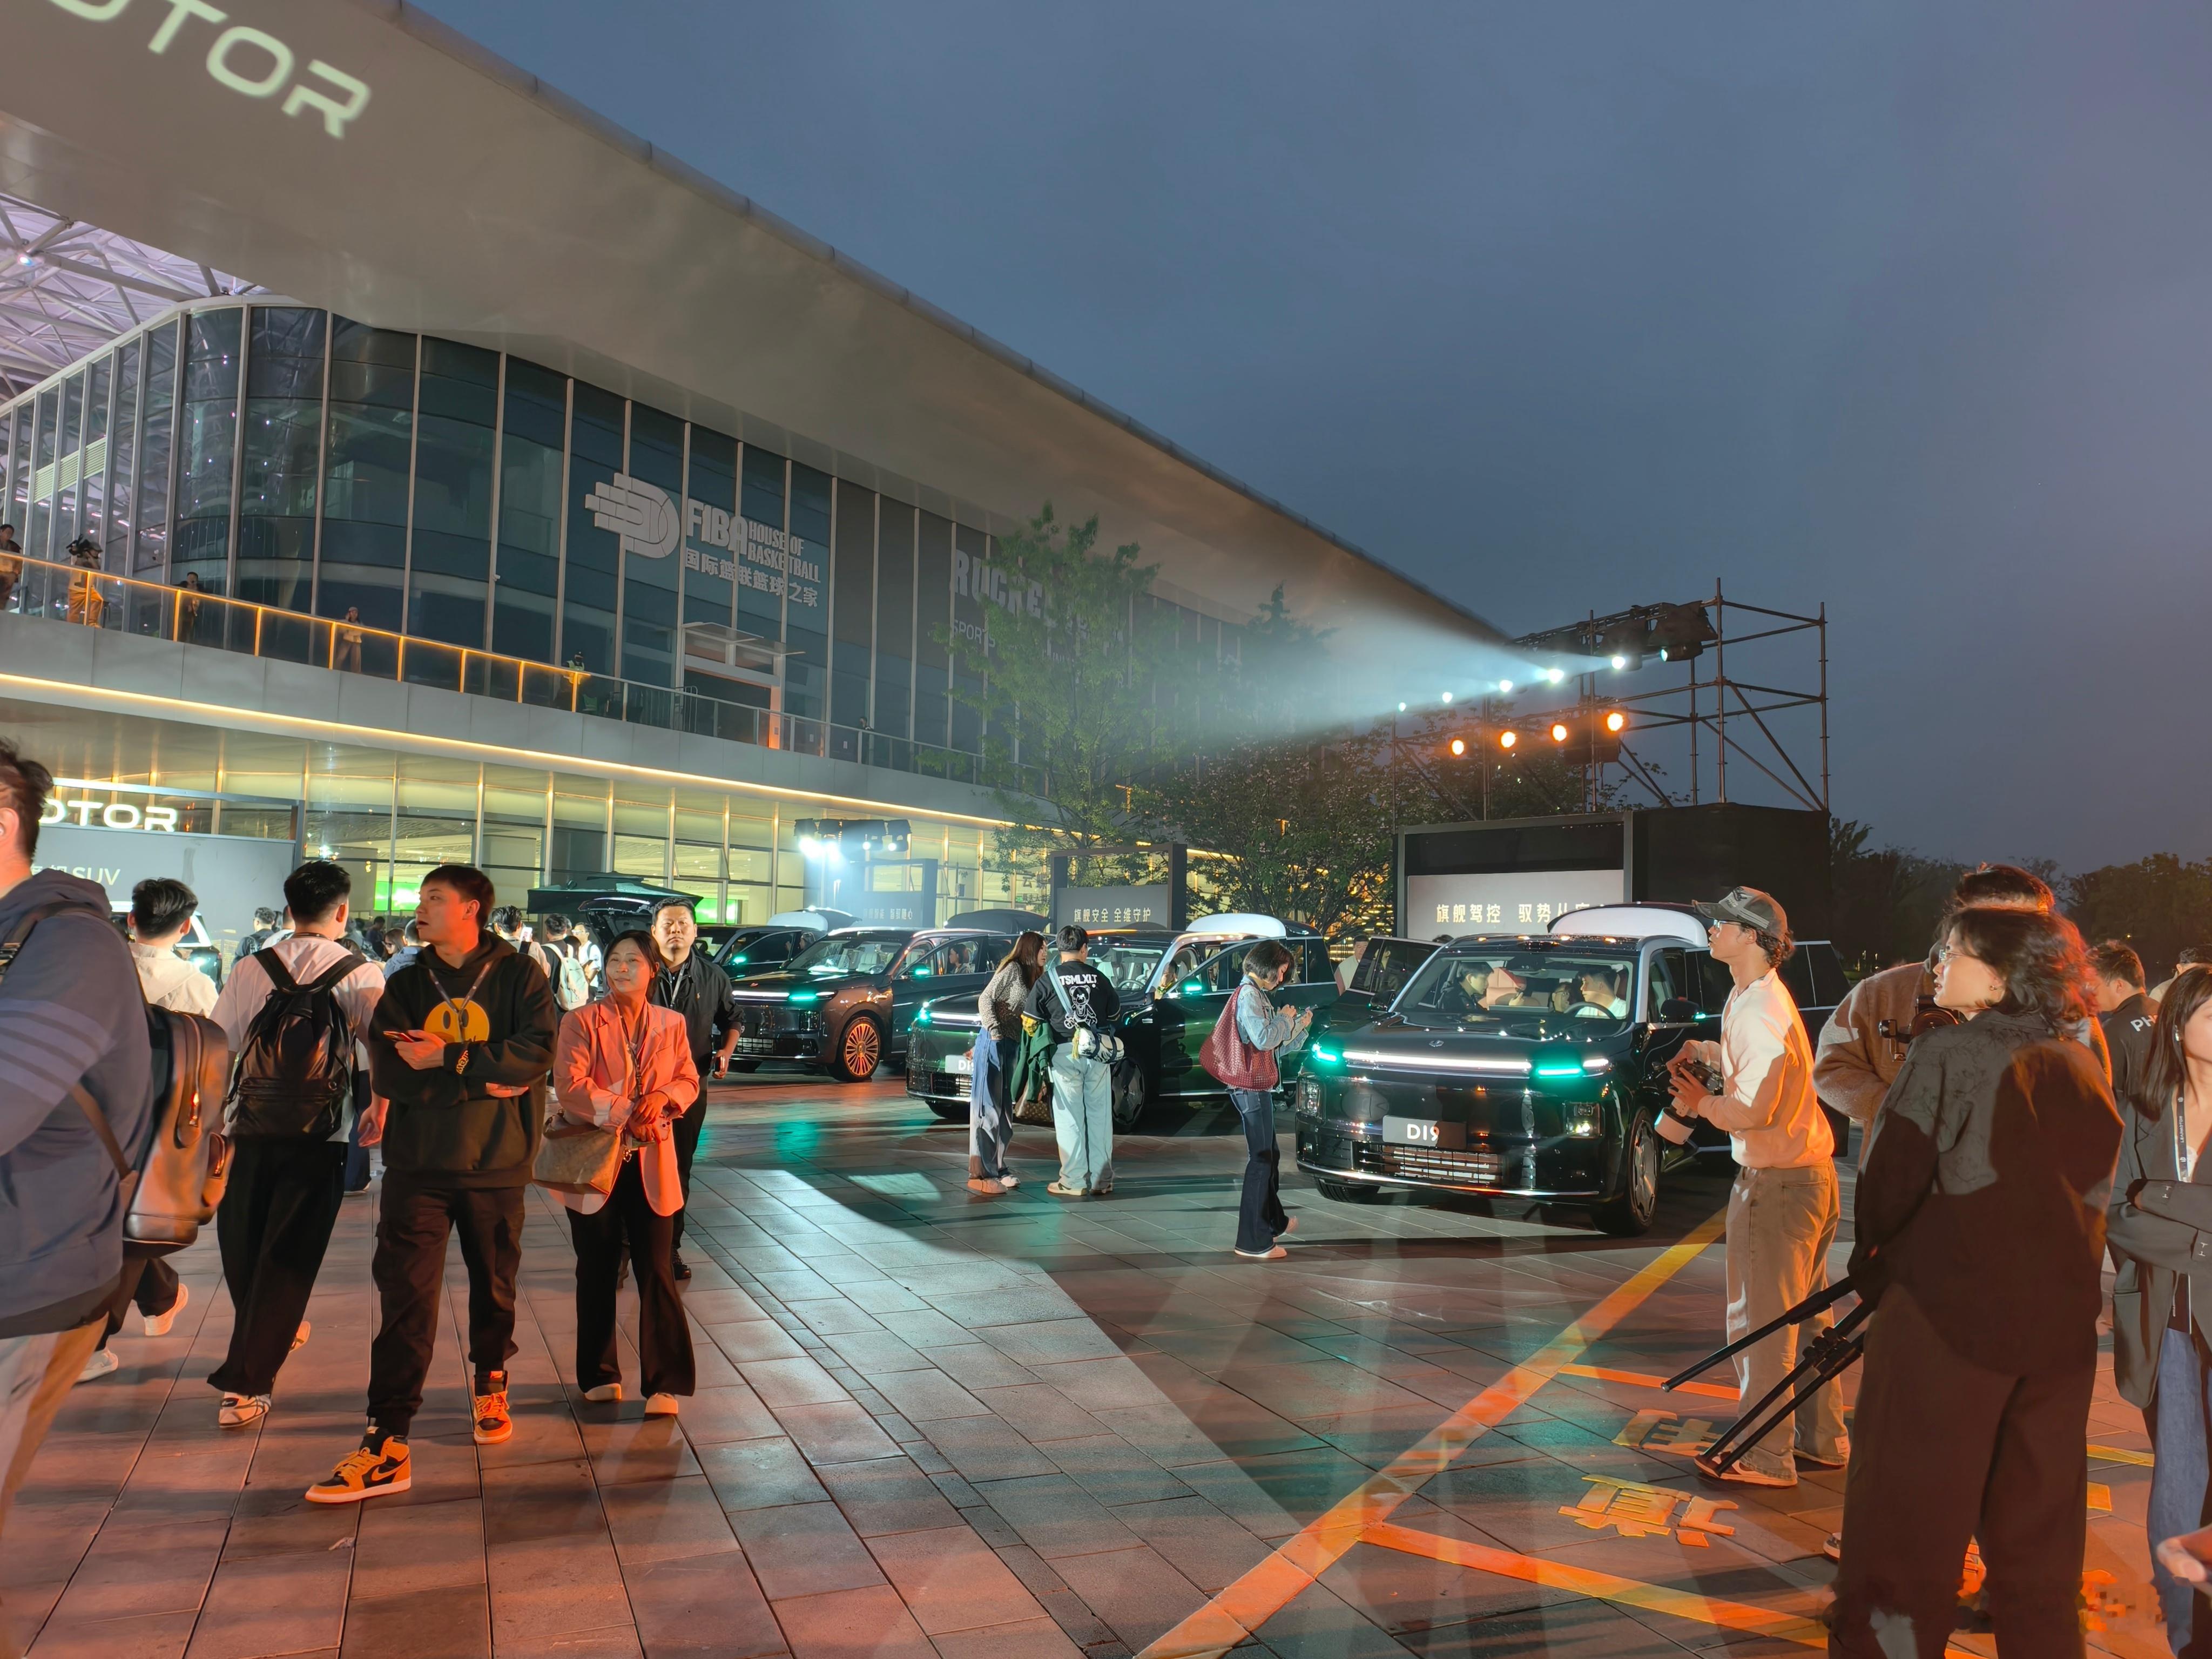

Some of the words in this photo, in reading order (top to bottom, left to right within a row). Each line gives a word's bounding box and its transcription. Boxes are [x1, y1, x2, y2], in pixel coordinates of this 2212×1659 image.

[686, 498, 748, 556] FIBA
[748, 521, 786, 550] HOUSE
[789, 536, 805, 556] OF
[685, 547, 818, 608] 国际篮联篮球之家
[747, 542, 821, 584] BASKETBALL
[72, 866, 121, 886] SUV
[1074, 908, 1109, 922] 旗舰安全
[1114, 907, 1151, 922] 全维守护
[1436, 903, 1501, 923] 旗舰驾控
